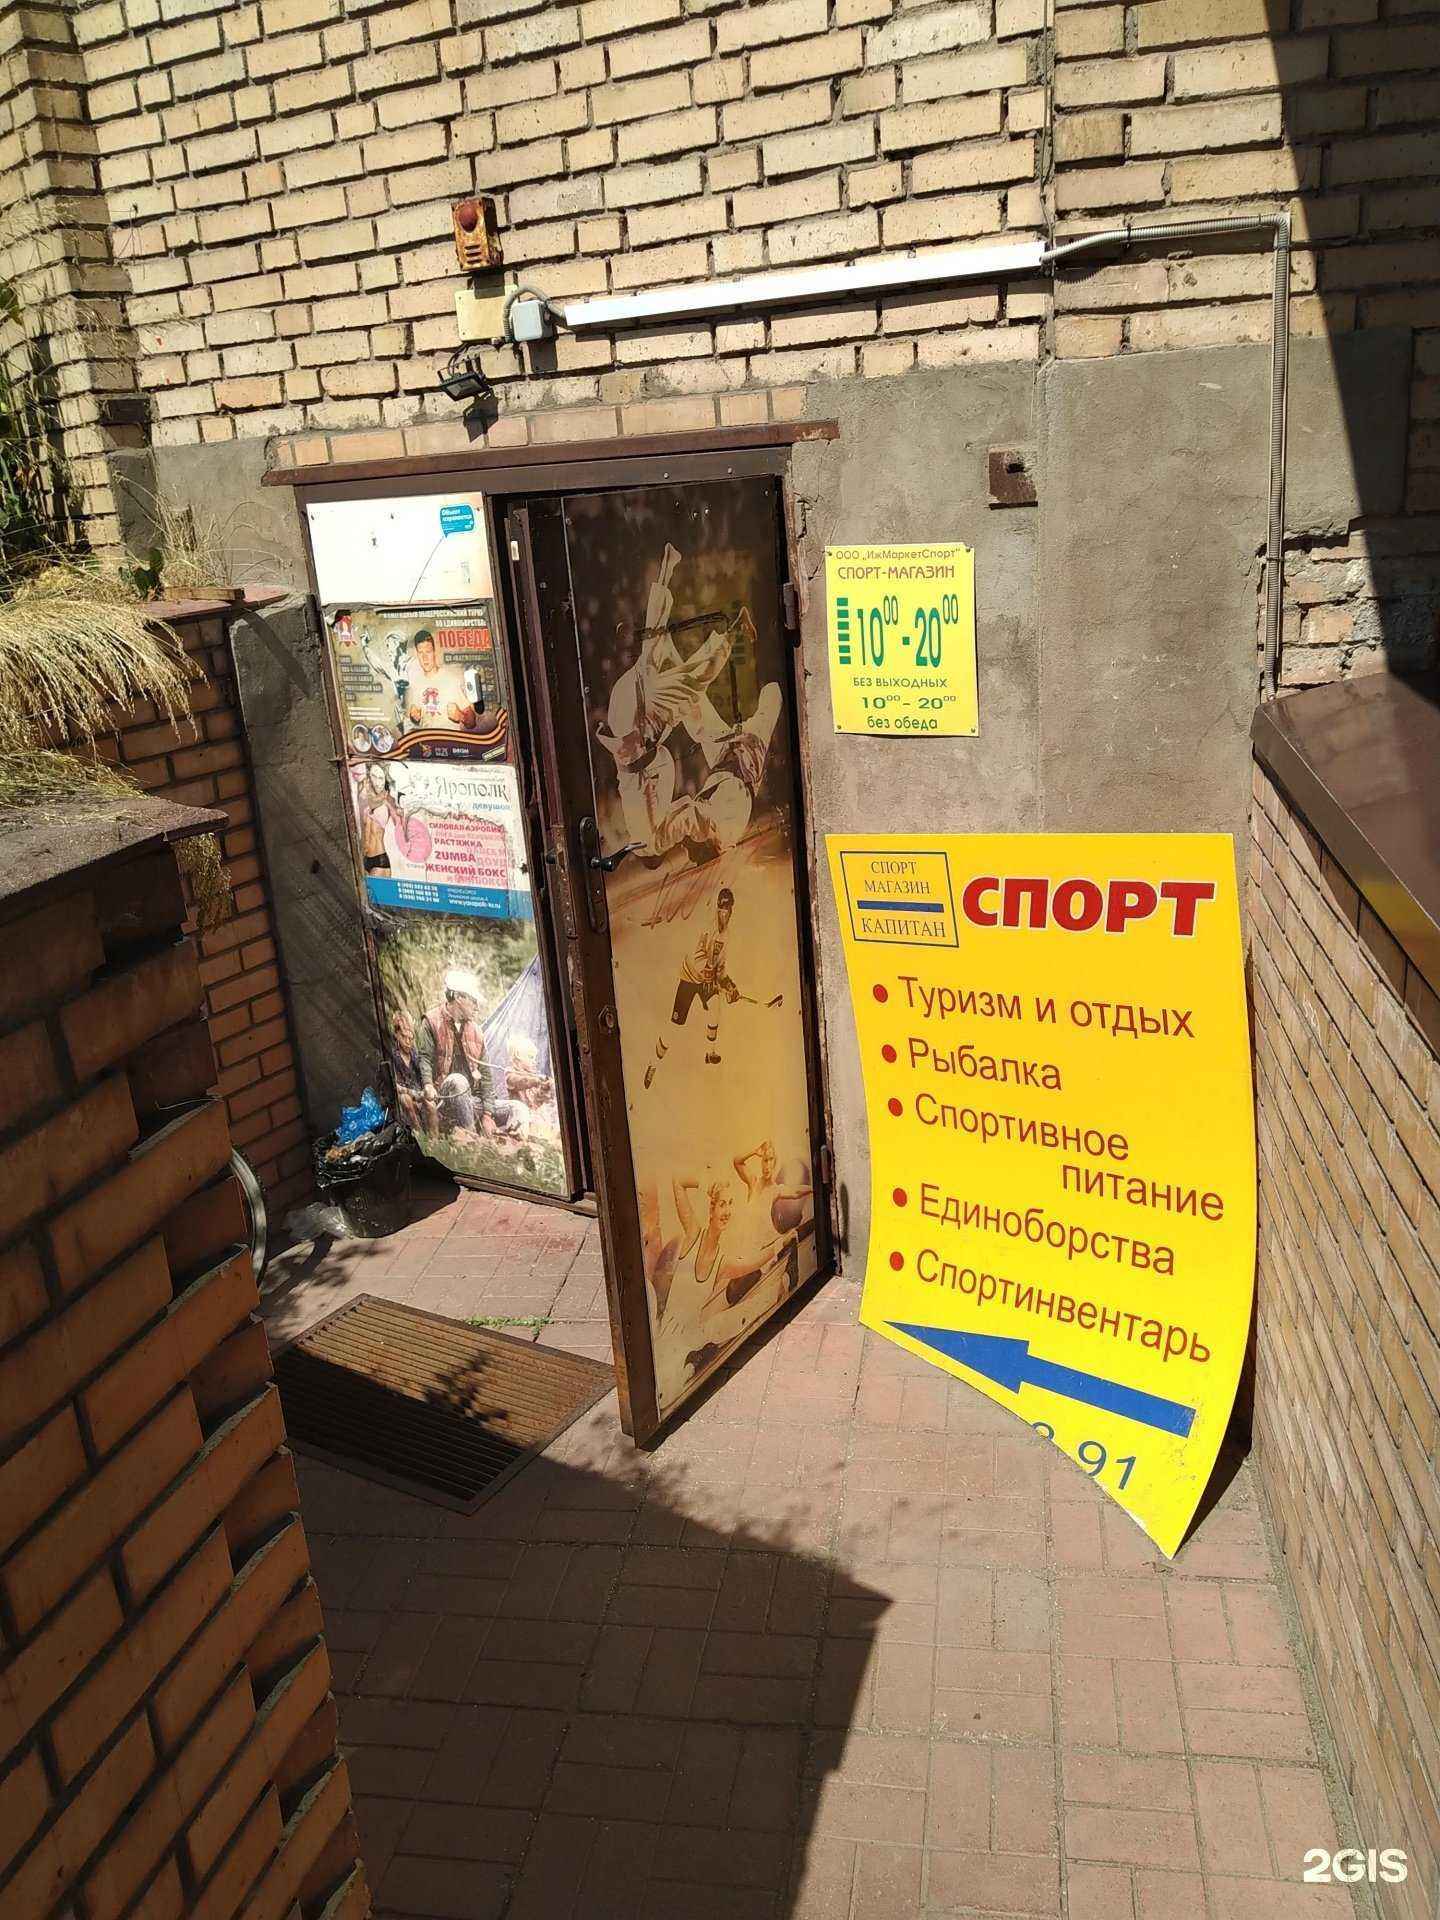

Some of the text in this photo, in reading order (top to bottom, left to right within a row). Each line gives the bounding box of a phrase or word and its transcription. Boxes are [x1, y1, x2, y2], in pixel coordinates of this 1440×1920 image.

[835, 550, 860, 560] ООО
[837, 565, 955, 580] СПОРТ-МАГАЗИН
[853, 677, 948, 688] БЕЗ ВЫХОДНЫХ
[867, 716, 938, 731] без обеда
[434, 838, 483, 848] РАСТЯЖКА
[434, 850, 477, 862] ZUMBA
[426, 863, 476, 876] ЖЕНСКИЙ
[478, 867, 507, 878] БОКС
[870, 860, 918, 875] СПОРТ
[864, 879, 931, 895] МАГАЗИН
[962, 877, 1216, 937] СПОРТ
[861, 918, 946, 938] КАПИТАН
[898, 975, 1195, 1039] Туризм и отдых
[908, 1037, 1062, 1090] Рыбалка
[915, 1093, 1129, 1161] Спортивное
[1062, 1164, 1225, 1221] питание
[920, 1183, 1176, 1276] Единоборства
[917, 1249, 1211, 1363] Спортинвентарь
